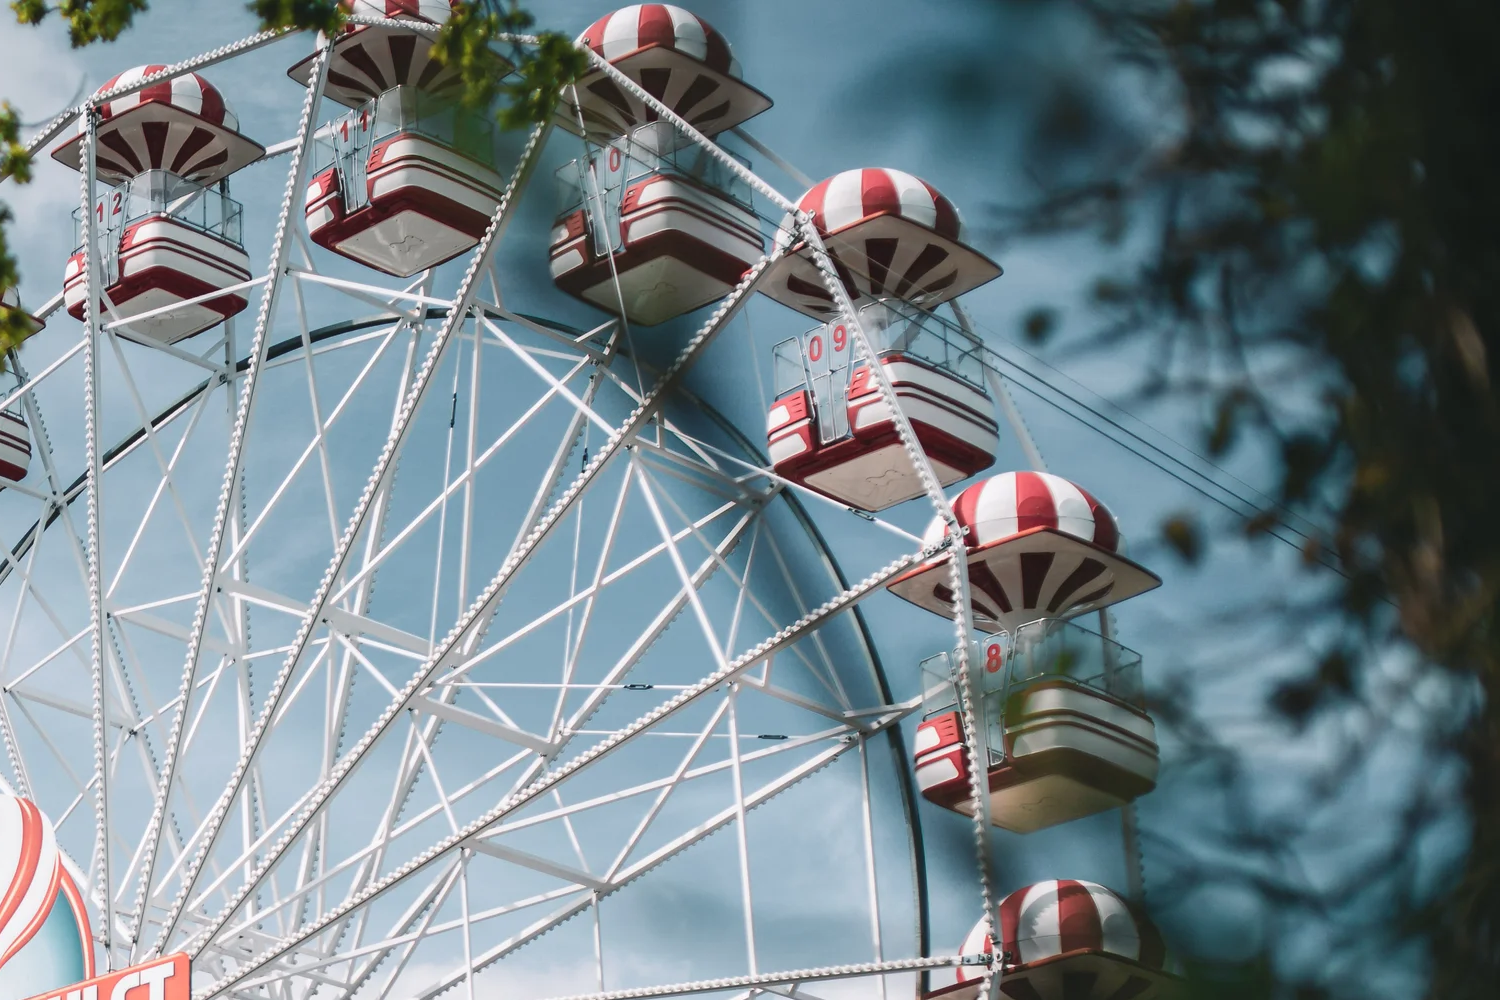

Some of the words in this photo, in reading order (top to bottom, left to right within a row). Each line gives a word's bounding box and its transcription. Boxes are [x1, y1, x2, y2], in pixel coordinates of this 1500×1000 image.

[340, 109, 368, 143] 11
[96, 191, 122, 223] 12
[809, 324, 847, 362] 09
